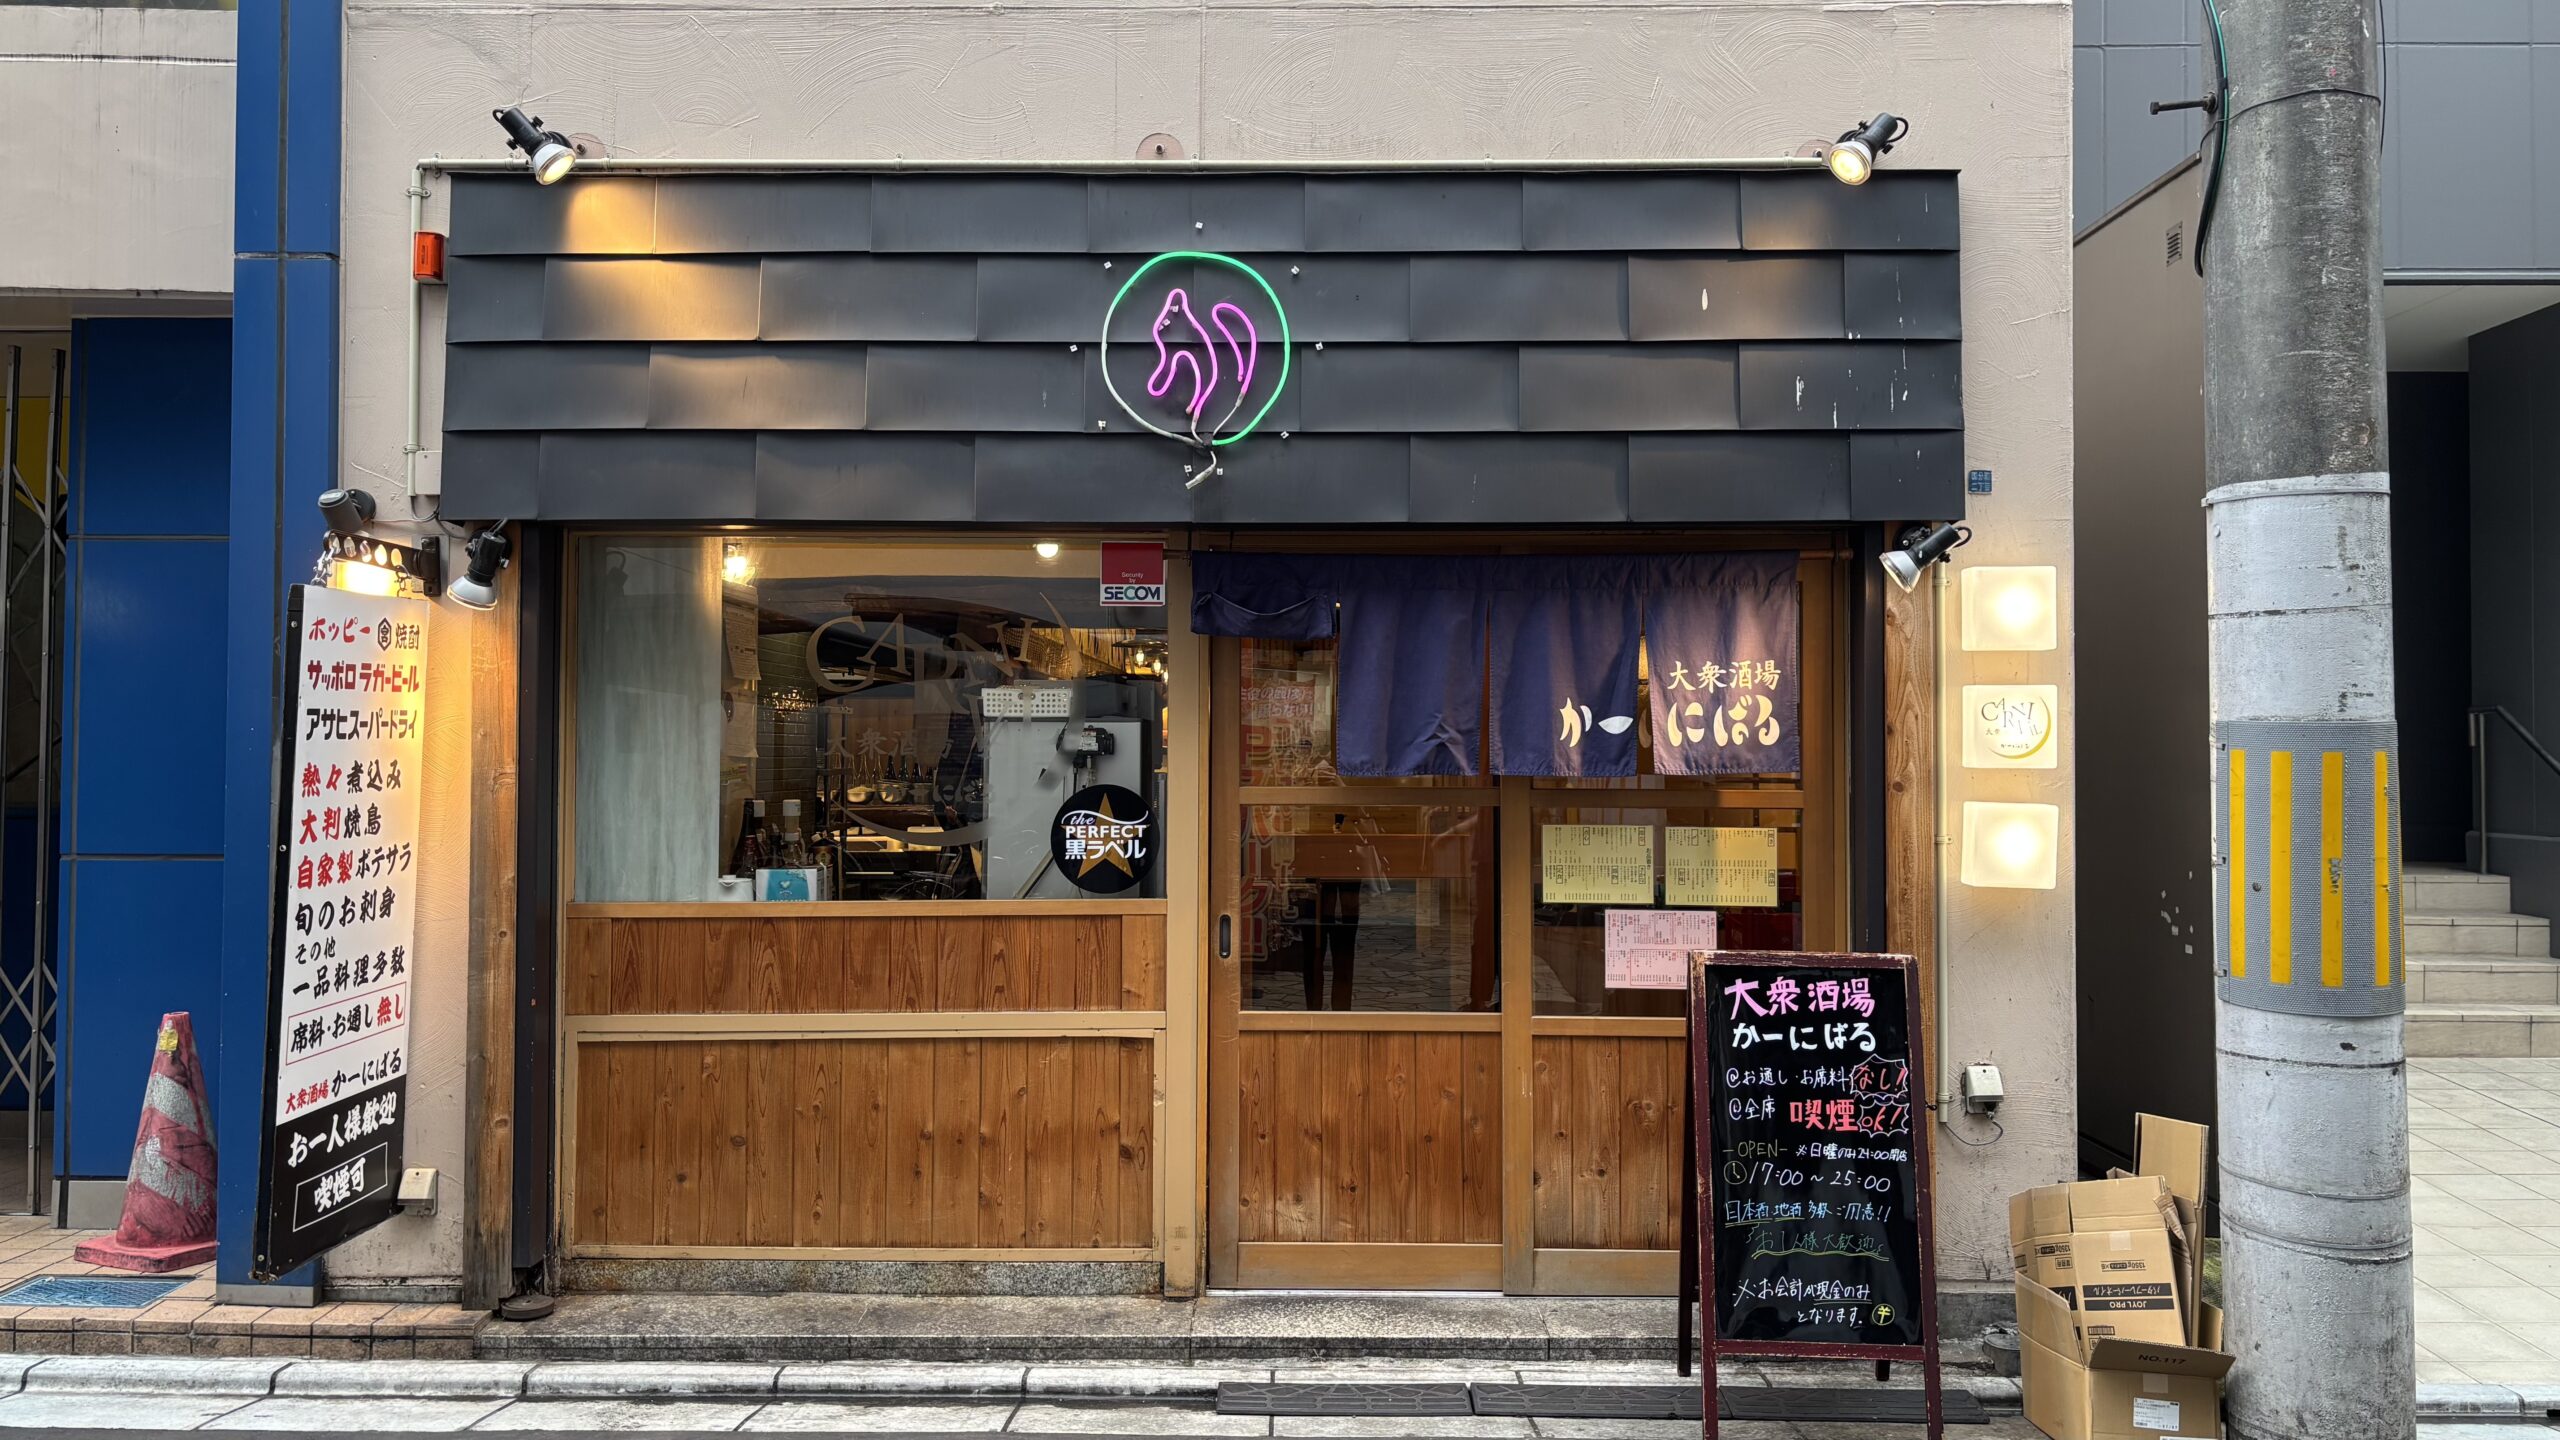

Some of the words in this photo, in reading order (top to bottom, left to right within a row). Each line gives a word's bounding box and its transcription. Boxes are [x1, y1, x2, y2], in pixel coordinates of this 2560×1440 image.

[1104, 585, 1160, 600] SECOM
[308, 616, 371, 644] ホッピー
[395, 622, 421, 650] 焼酎
[1668, 659, 1782, 694] 大衆酒場
[306, 707, 418, 741] アサヒスーパードライ
[301, 759, 401, 798] 熱々煮込み
[299, 802, 382, 845] 大判焼鳥
[1065, 825, 1147, 839] PERFECT
[297, 841, 412, 890] 自家製ポテサラ
[1065, 839, 1147, 860] 黒ラベル
[295, 885, 395, 937] 旬のお刺身
[294, 936, 336, 965] その他
[292, 945, 405, 998] 一品料理多数
[1724, 976, 1876, 1020] 大衆酒場
[1732, 1022, 1876, 1052] かーにばる
[331, 1047, 402, 1097] かーにばる
[288, 1090, 397, 1168] お一人様歓迎
[1790, 1099, 1859, 1132] 喫煙
[313, 1157, 367, 1214] 喫煙可
[2093, 1285, 2161, 1297] バターフレーバーオイル
[2108, 1300, 2126, 1309] PRO
